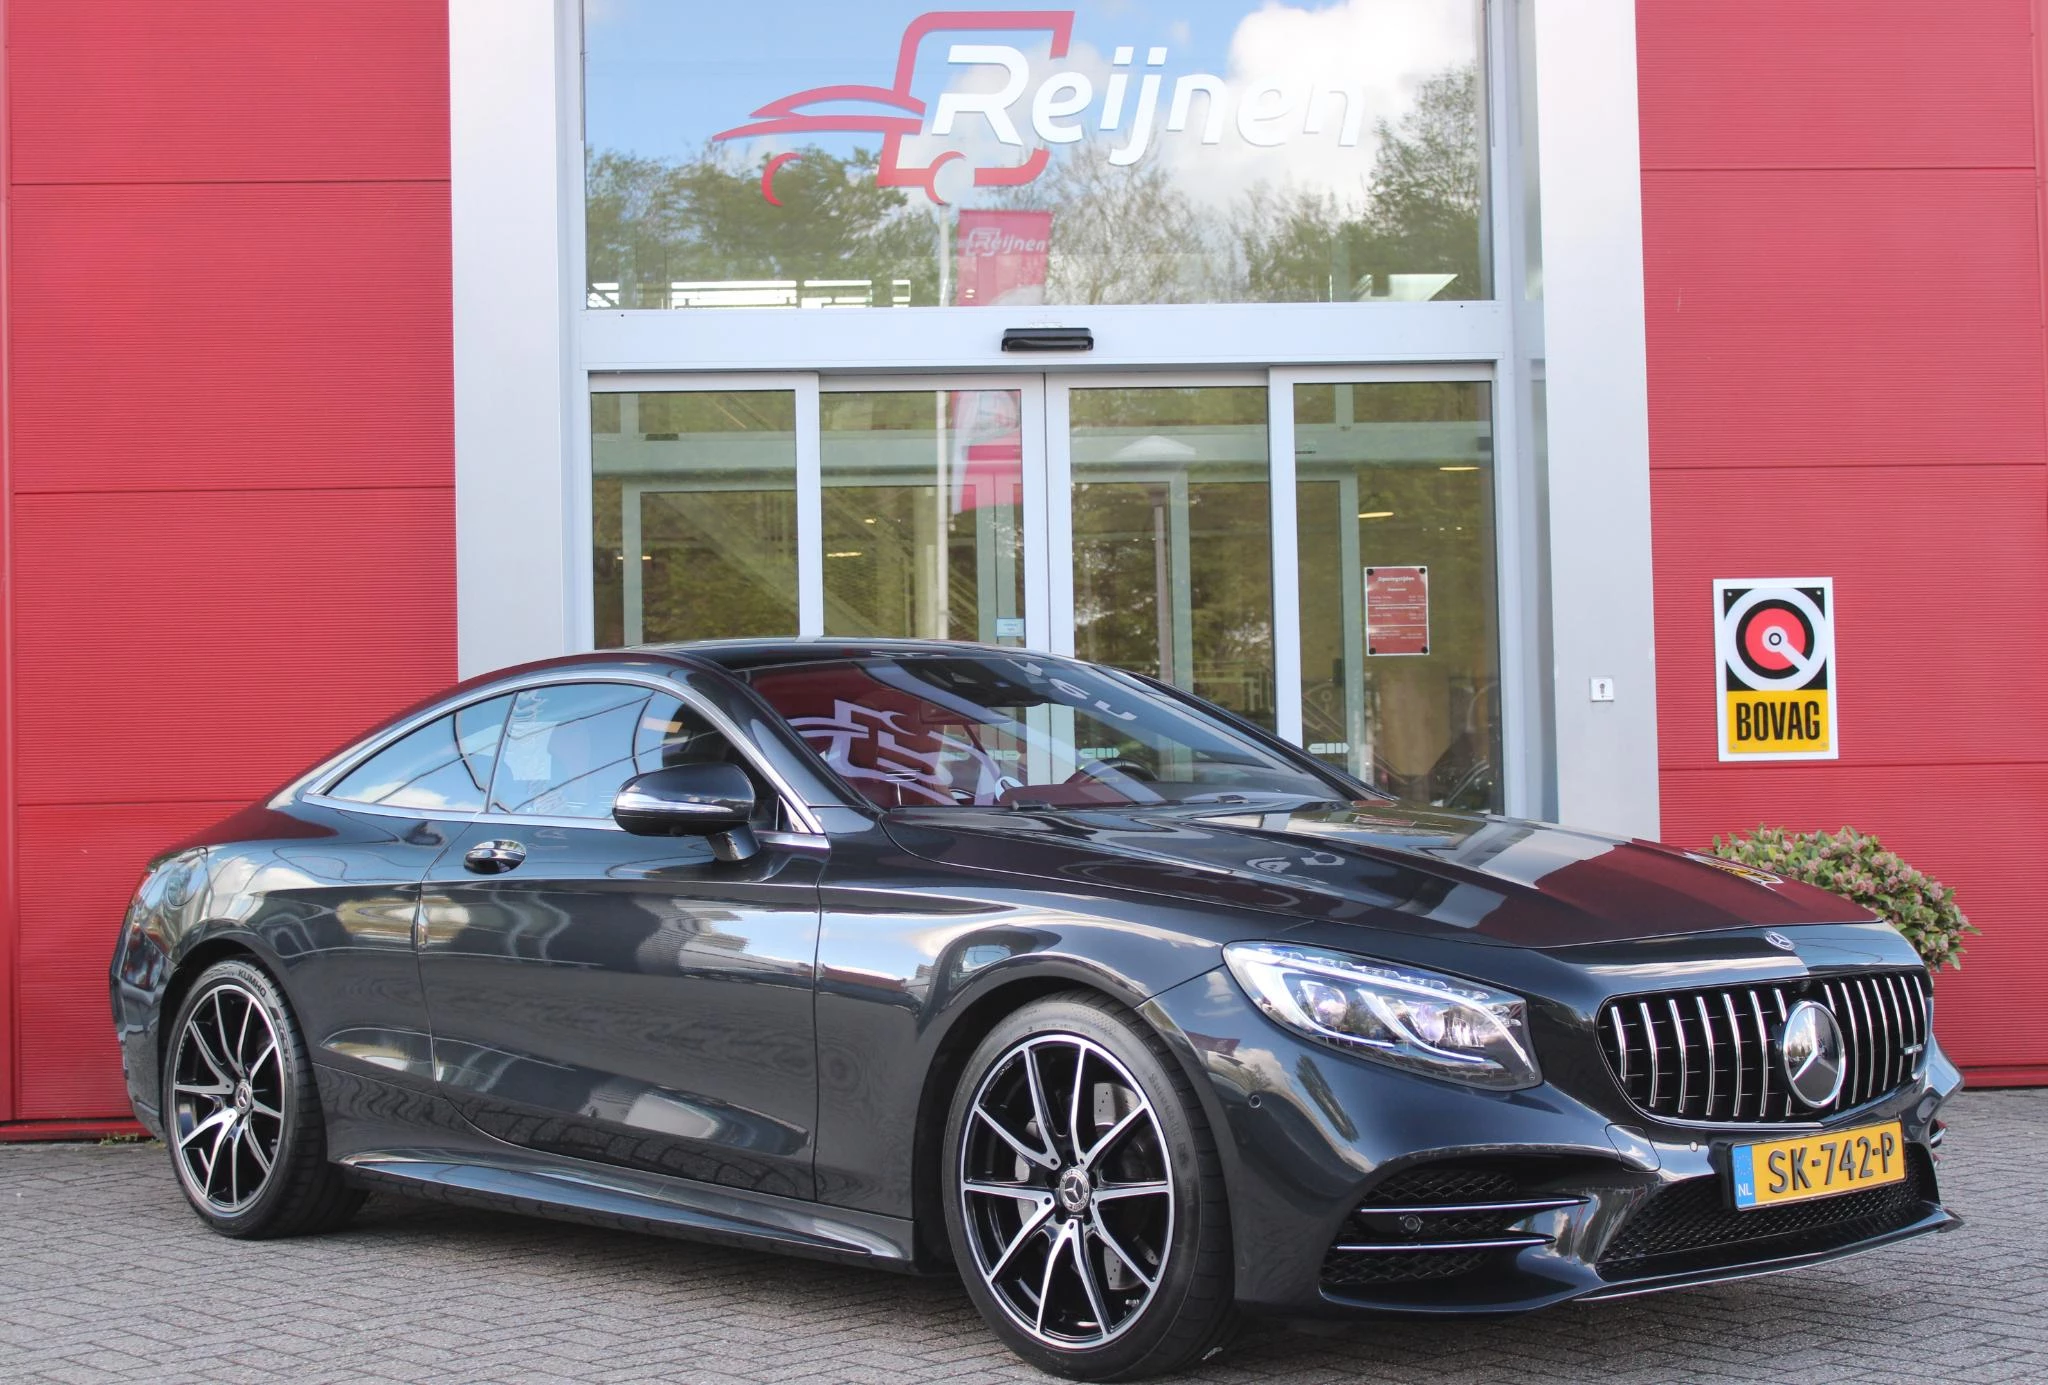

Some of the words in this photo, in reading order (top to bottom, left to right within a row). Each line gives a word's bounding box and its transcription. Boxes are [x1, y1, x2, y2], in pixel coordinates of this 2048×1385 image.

[931, 45, 1365, 166] Reijnen
[974, 232, 1047, 254] Reijnen
[1736, 700, 1821, 741] BOVAG
[238, 969, 267, 997] KUMHO
[1768, 1131, 1895, 1194] SK-742-P
[1738, 1183, 1753, 1197] NL
